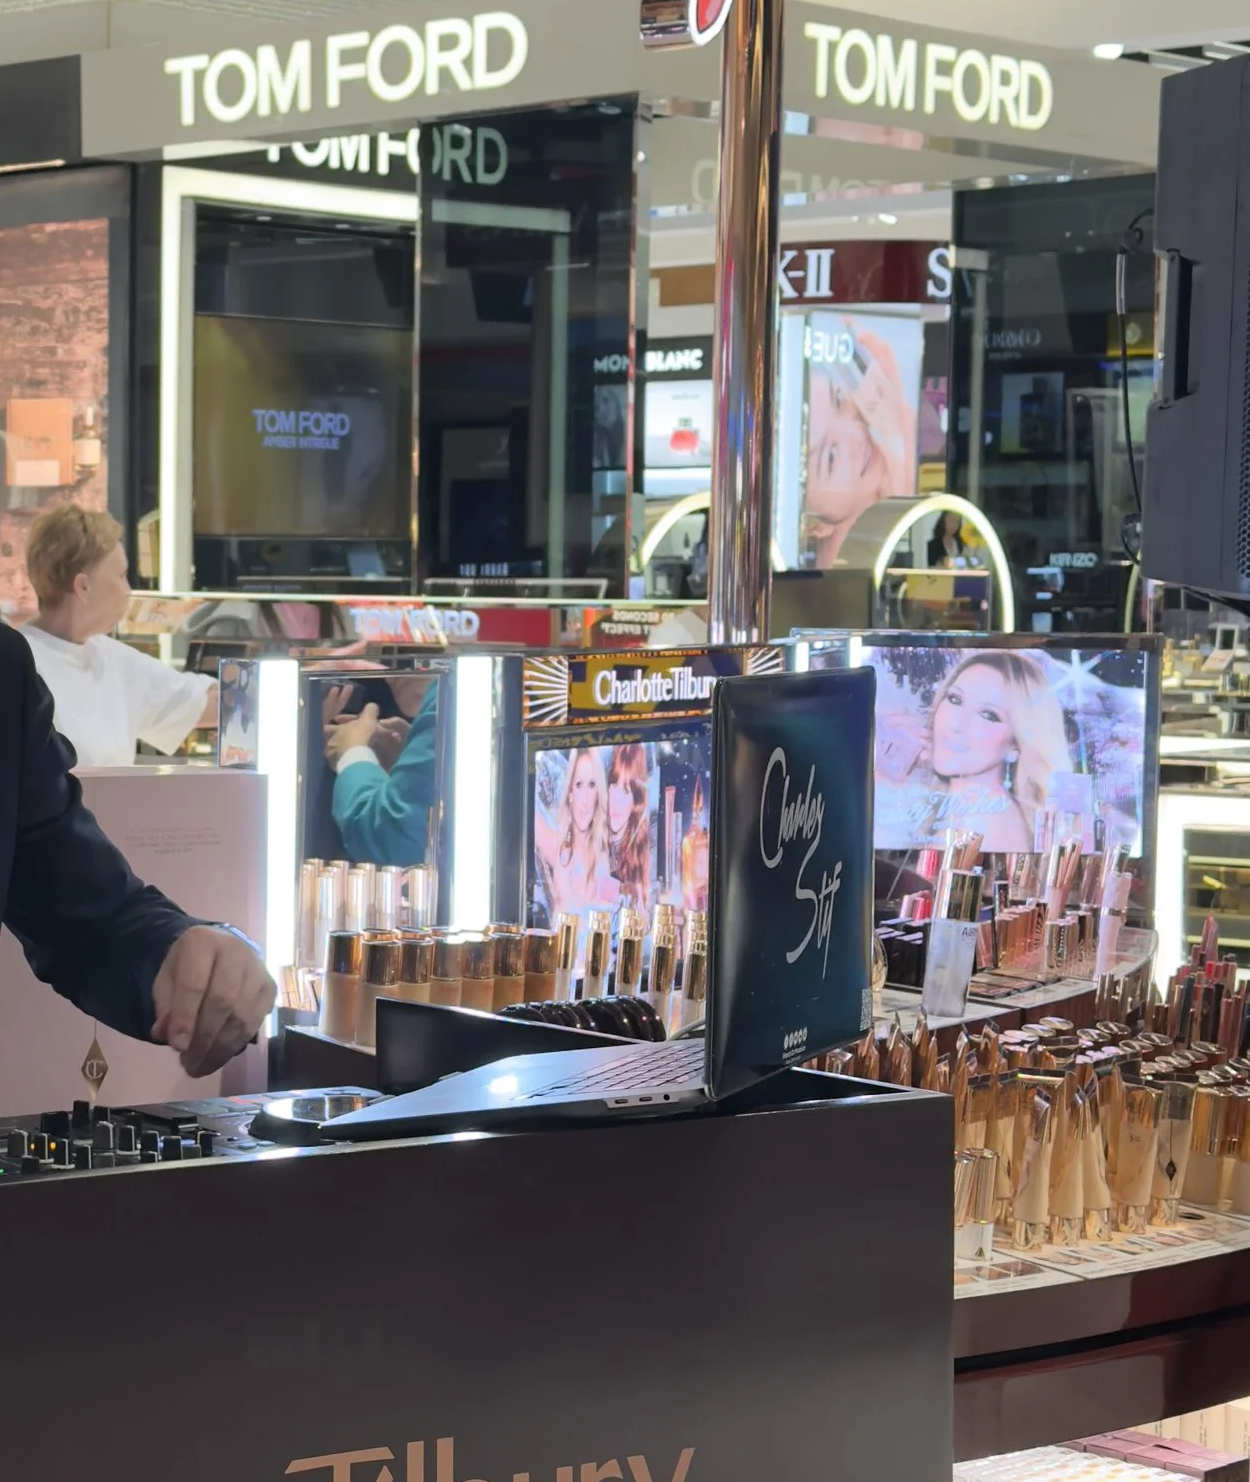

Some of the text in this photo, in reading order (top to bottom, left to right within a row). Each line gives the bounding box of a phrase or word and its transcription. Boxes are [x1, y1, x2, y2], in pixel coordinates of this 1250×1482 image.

[164, 11, 529, 126] TOM FORD
[804, 21, 1053, 131] TOM FORD
[776, 248, 836, 298] K-II
[593, 348, 703, 374] MONBLANC
[252, 409, 350, 436] TOM FORD
[349, 607, 403, 635] TOM
